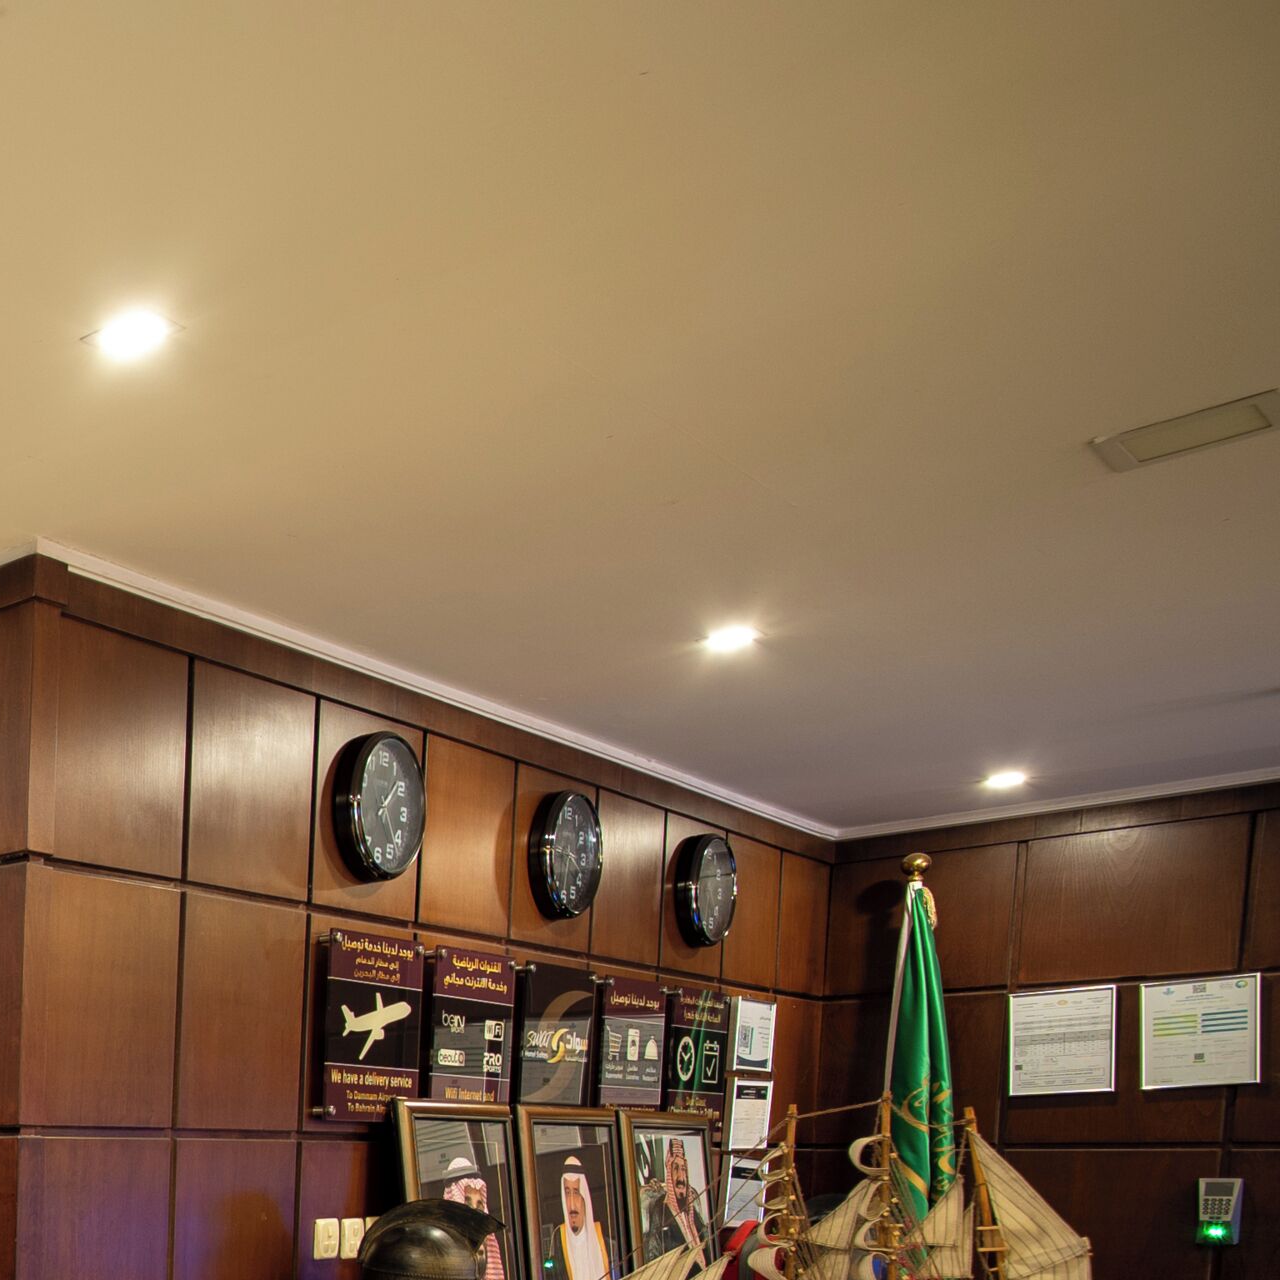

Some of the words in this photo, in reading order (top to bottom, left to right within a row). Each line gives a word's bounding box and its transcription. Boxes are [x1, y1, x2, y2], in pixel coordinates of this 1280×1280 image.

[378, 750, 390, 767] 12
[397, 781, 406, 797] 2
[399, 807, 408, 822] 3
[393, 829, 402, 847] 4
[373, 847, 382, 864] 6
[385, 843, 394, 859] 5
[341, 934, 364, 952] توصيل
[364, 938, 381, 953] خدمة
[382, 941, 398, 957] لدينا
[399, 948, 414, 961] يوجد
[452, 954, 479, 971] الرياضية
[479, 959, 502, 974] القنوات
[443, 972, 464, 989] مجاني
[487, 978, 508, 994] وخدمة
[610, 990, 631, 1007] توصيل
[631, 994, 646, 1008] لدينا
[483, 1052, 502, 1066] PRO
[331, 1068, 341, 1084] We
[342, 1069, 358, 1085] have
[364, 1071, 390, 1089] delivery
[390, 1074, 413, 1088] service
